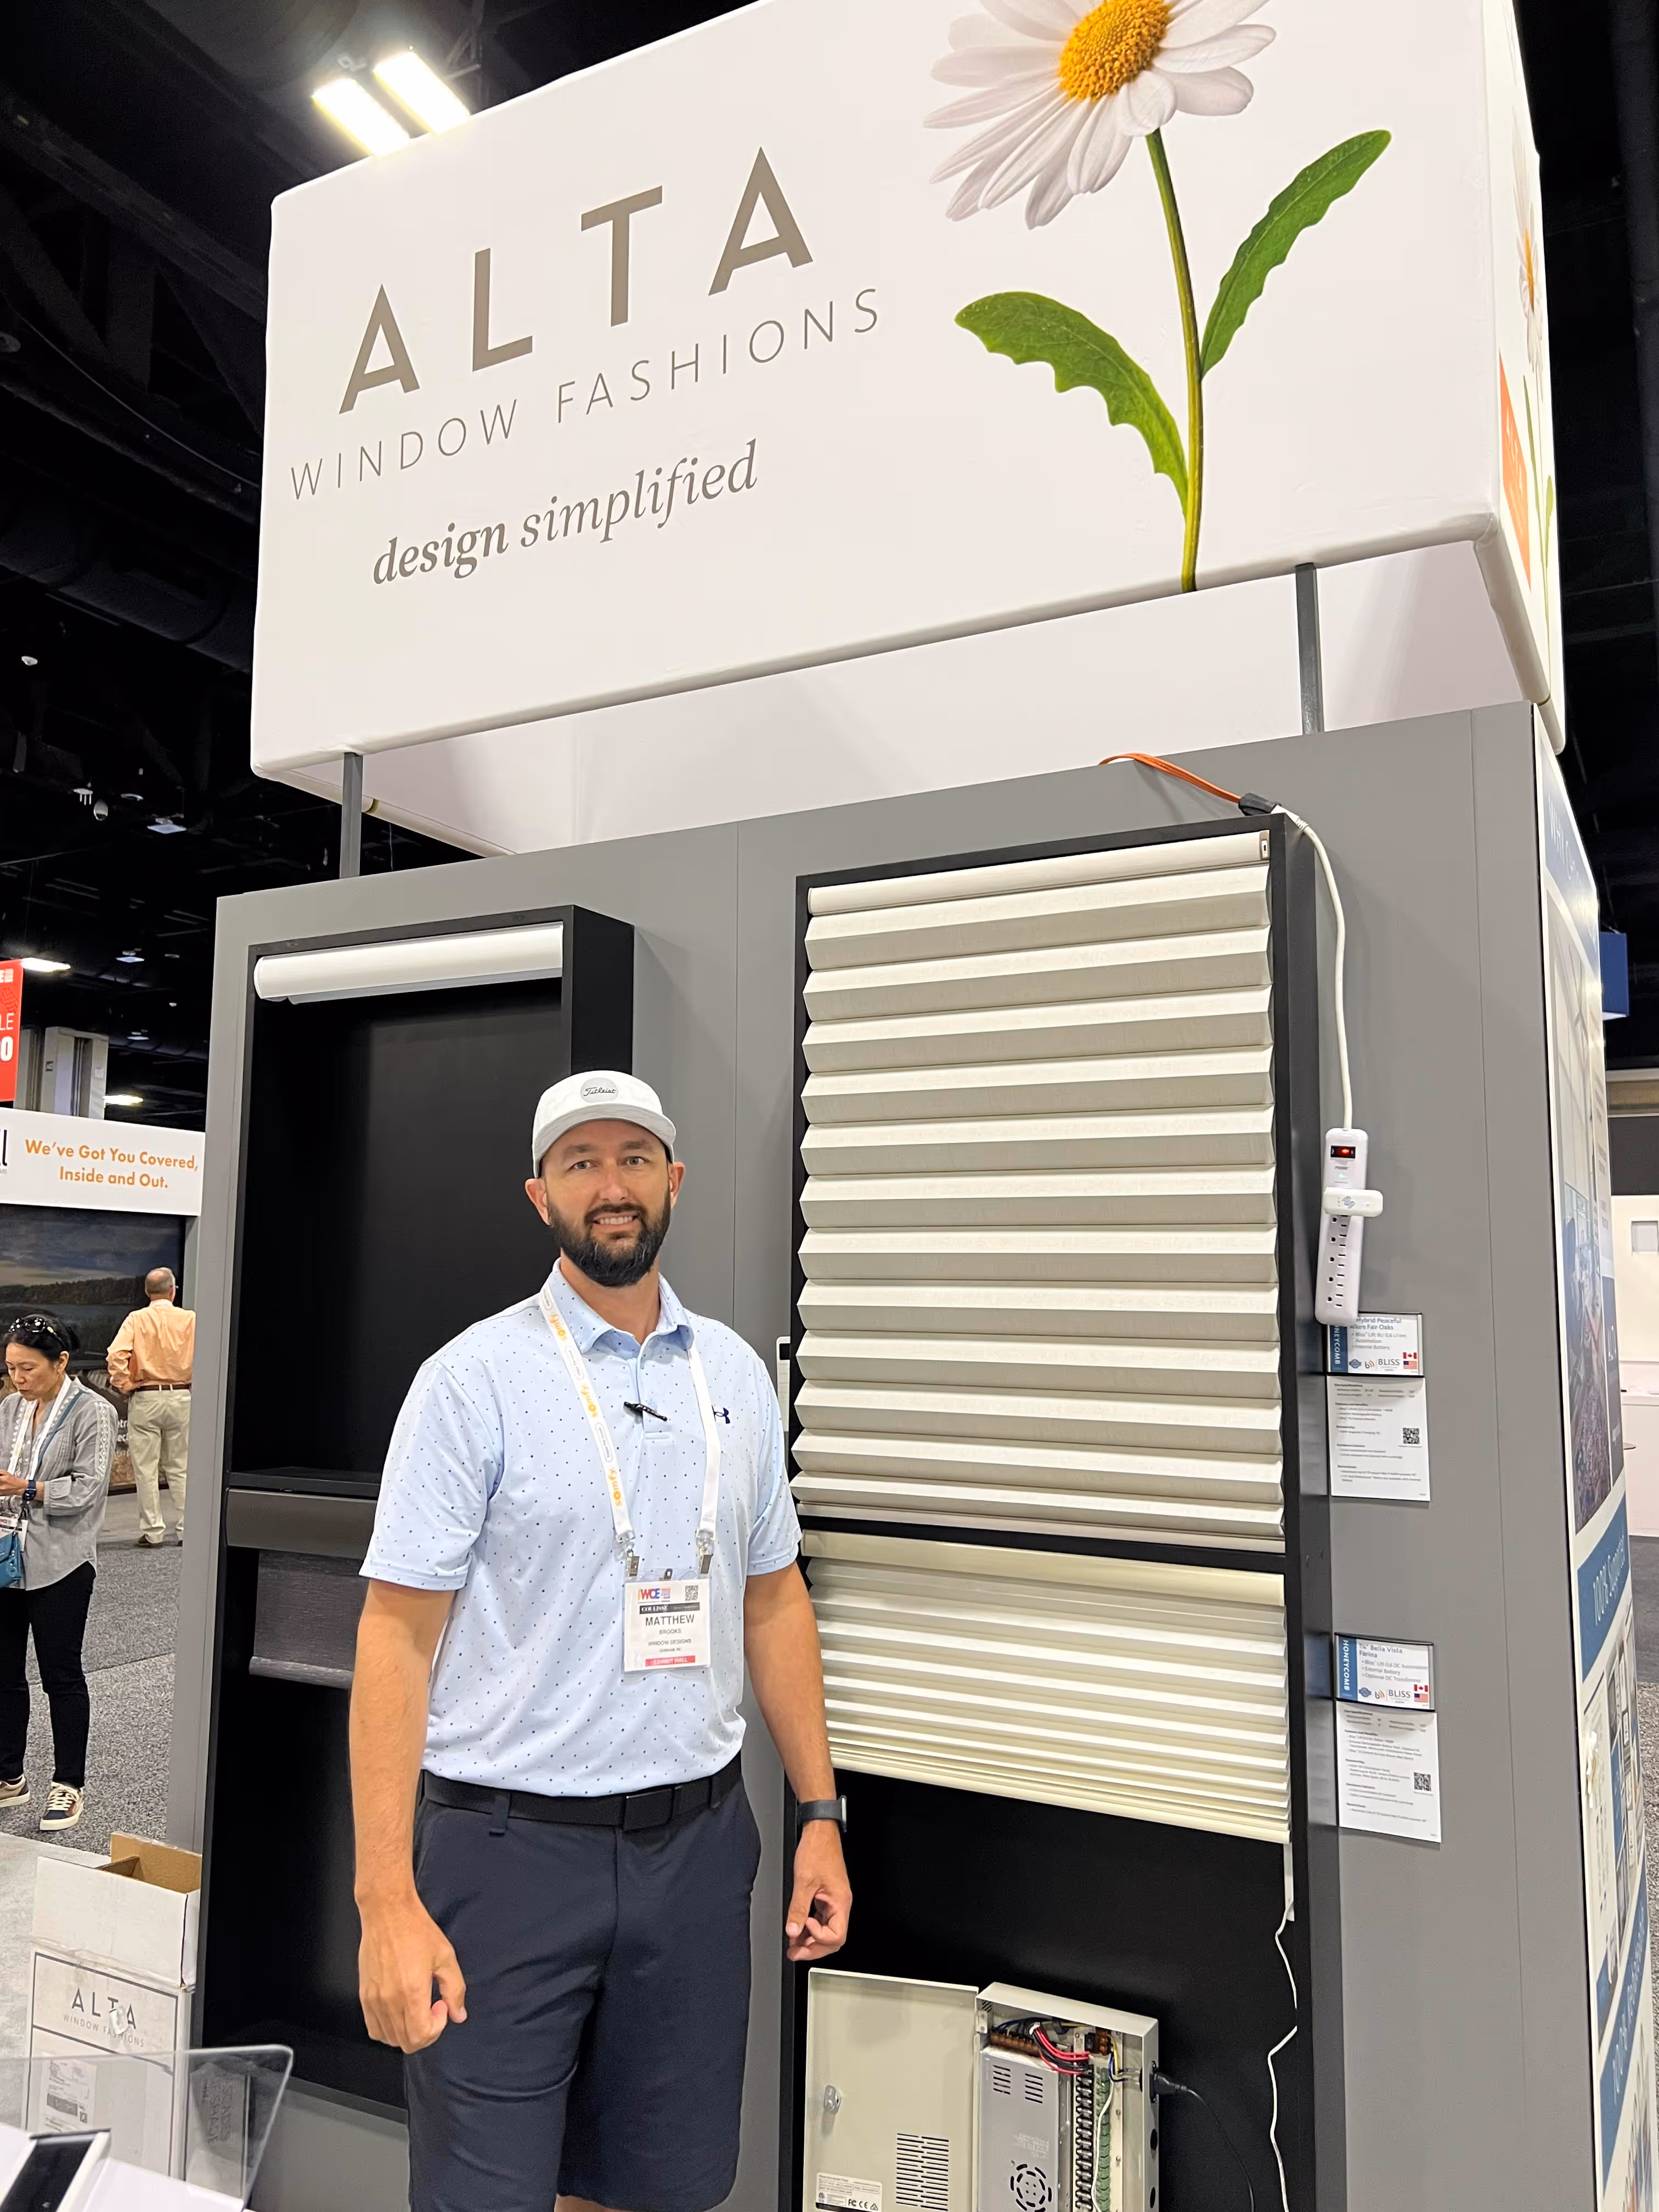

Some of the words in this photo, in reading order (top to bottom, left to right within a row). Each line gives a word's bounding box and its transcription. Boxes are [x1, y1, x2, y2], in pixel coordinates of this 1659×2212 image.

[338, 146, 814, 415] ALTA
[291, 399, 517, 500] WINDOW
[557, 287, 879, 424] FASHIONS
[373, 522, 509, 585] design
[521, 438, 758, 543] simplified
[583, 1087, 617, 1097] Titleist
[25, 1138, 74, 1158] We've
[79, 1144, 105, 1160] Got
[109, 1148, 136, 1163] You
[139, 1151, 199, 1172] Covered,
[59, 1166, 104, 1183] Inside
[108, 1171, 136, 1186] and
[139, 1173, 168, 1189] Out.
[580, 1385, 598, 1418] somfy
[608, 1468, 622, 1506] somfy
[645, 1614, 695, 1626] MATTHEW
[1389, 1690, 1410, 1698] BLISS
[63, 2013, 99, 2032] WINDOW
[71, 1988, 137, 2029] ALTA
